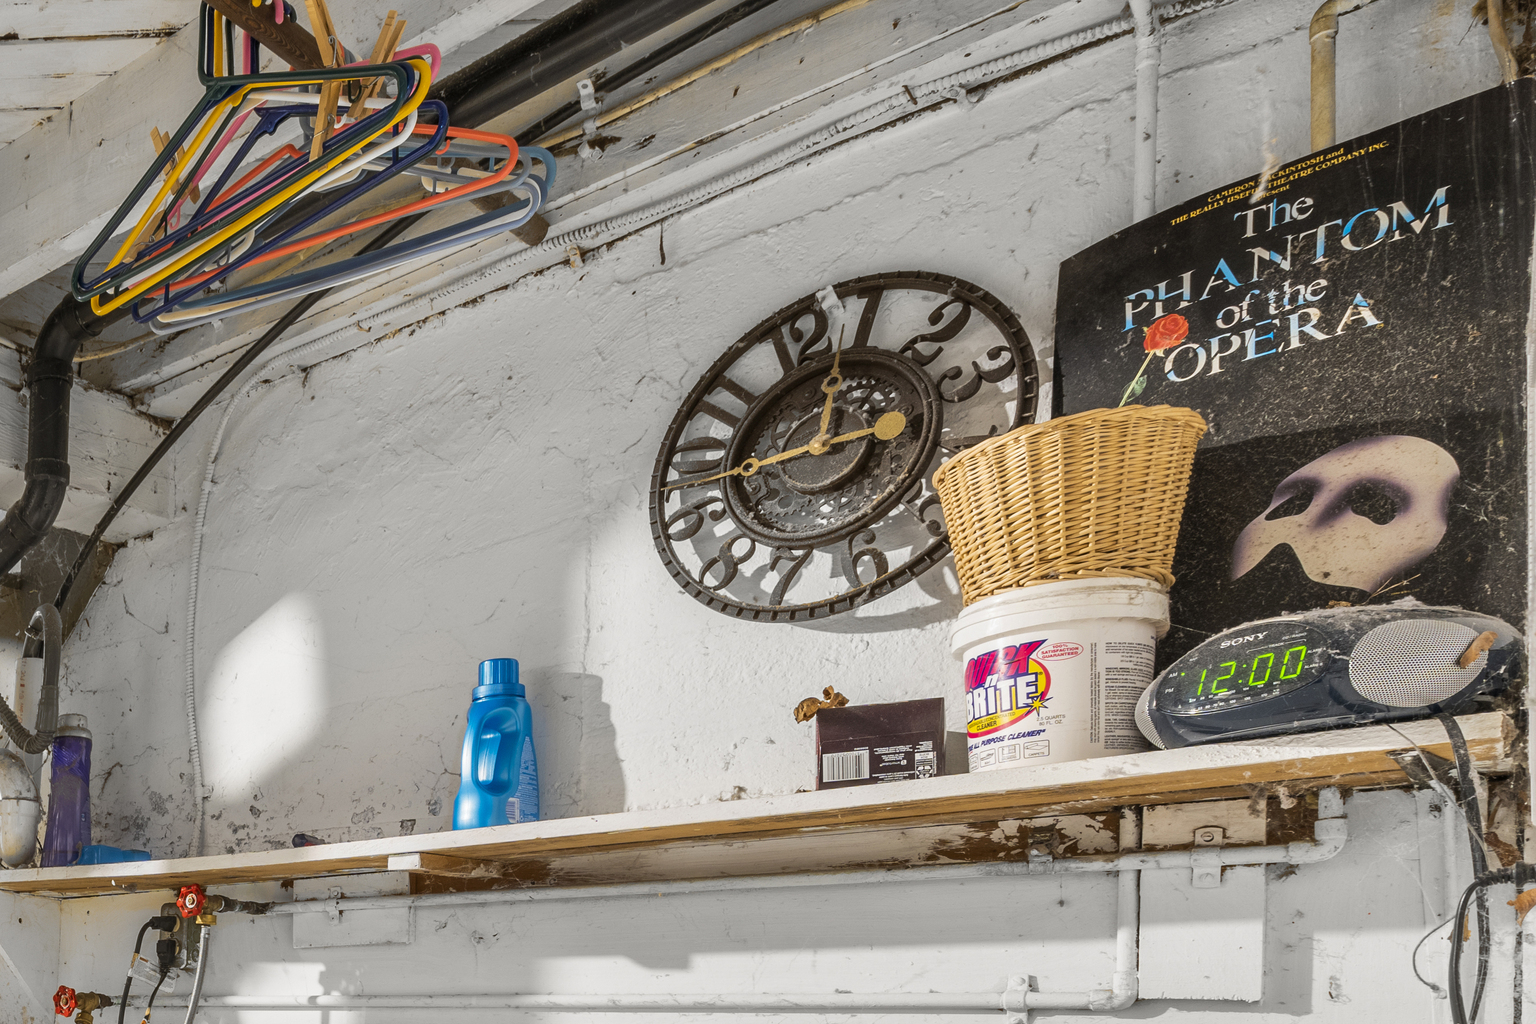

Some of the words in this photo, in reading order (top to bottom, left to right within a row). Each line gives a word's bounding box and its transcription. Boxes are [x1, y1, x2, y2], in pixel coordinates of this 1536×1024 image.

[1170, 214, 1189, 226] THE
[1190, 200, 1224, 218] REALLY
[1226, 184, 1265, 204] USEFU
[1266, 165, 1314, 189] THEATRE
[1315, 148, 1367, 171] COMPANY
[1369, 140, 1390, 153] INC.
[1207, 181, 1255, 202] CAMERON
[1257, 154, 1324, 184] ACKINTOSH
[1325, 148, 1344, 160] and
[1233, 196, 1314, 239] The
[1121, 185, 1455, 332] PHANTOM
[1216, 289, 1261, 329] of
[1263, 276, 1328, 312] the
[1164, 292, 1383, 383] OPERA
[1041, 647, 1079, 655] SATISFACTION
[1042, 651, 1079, 659] GUARANTEED
[1220, 631, 1268, 649] SONY
[1197, 645, 1307, 696] 12:00
[976, 720, 997, 731] CLEANER
[980, 735, 1007, 746] PURPOSE
